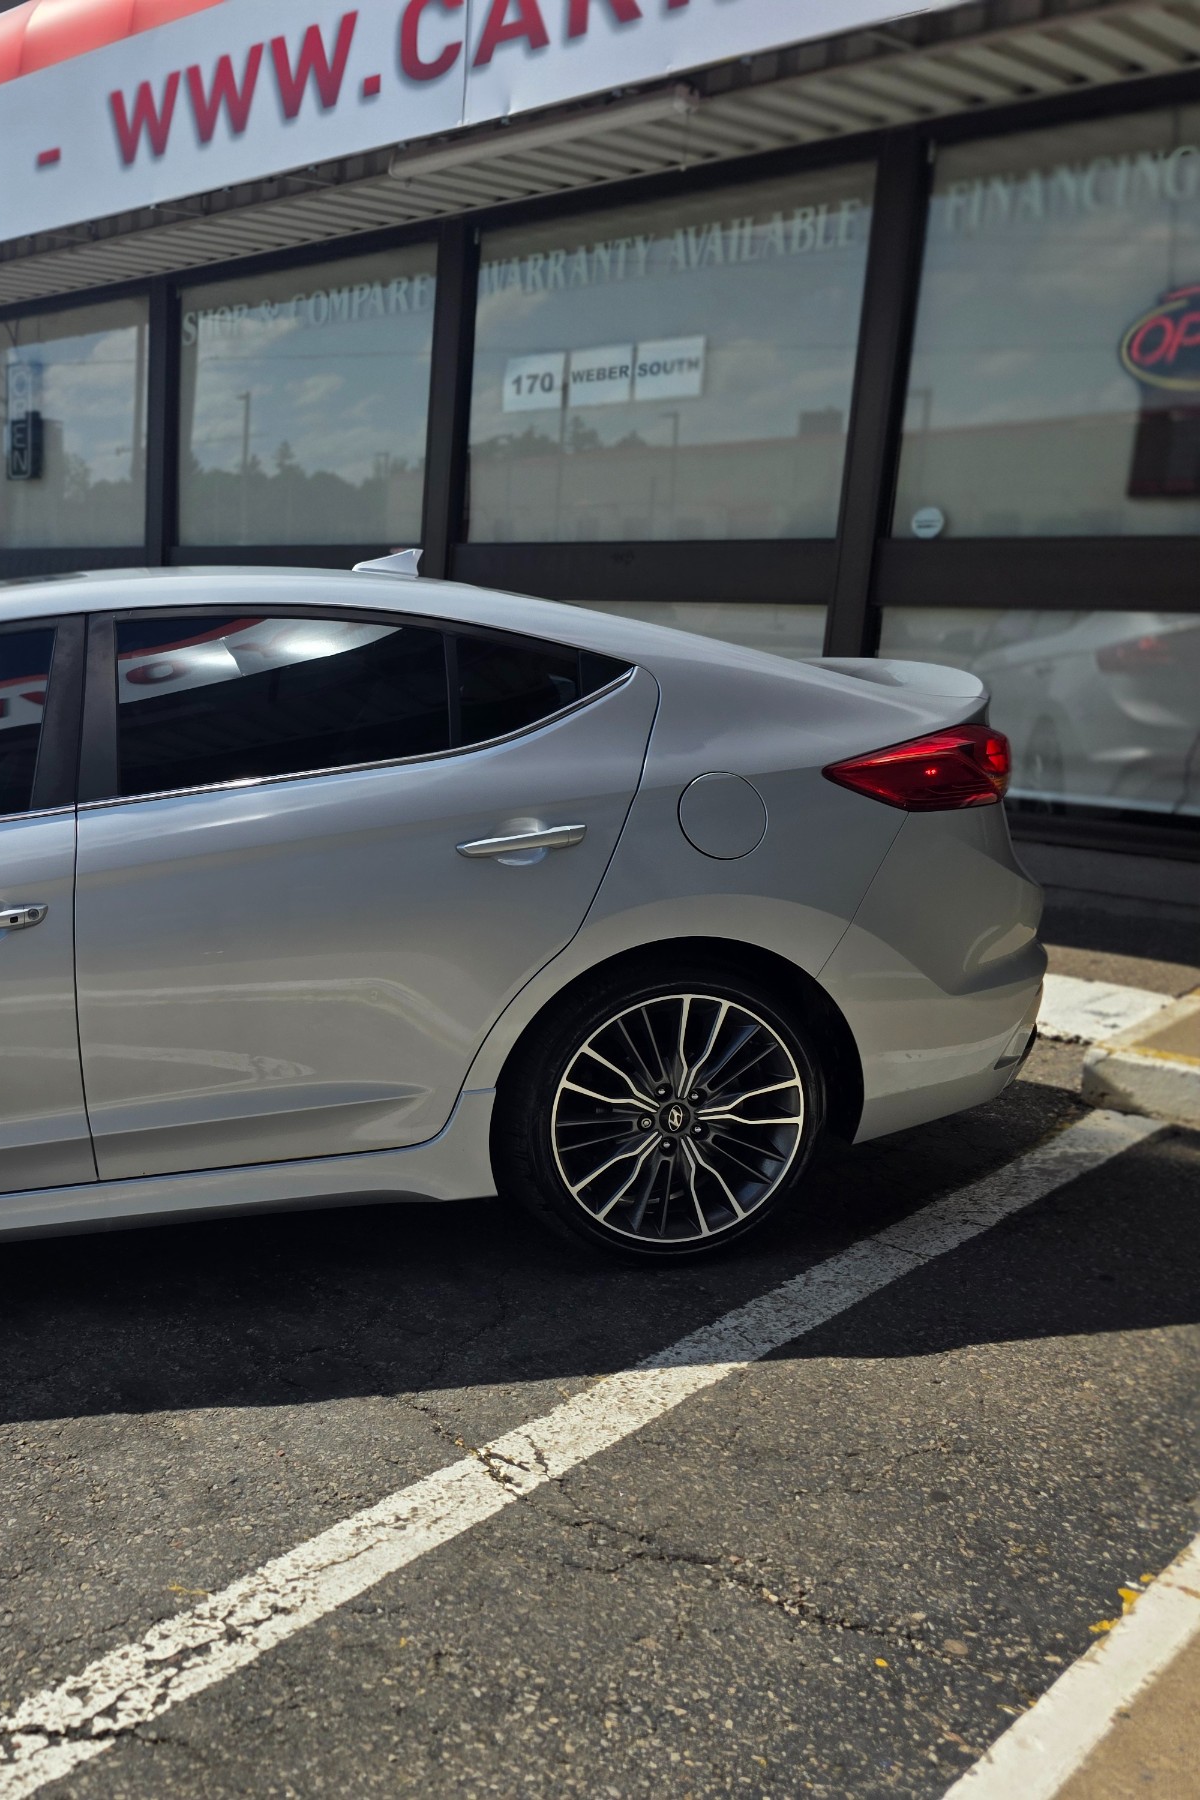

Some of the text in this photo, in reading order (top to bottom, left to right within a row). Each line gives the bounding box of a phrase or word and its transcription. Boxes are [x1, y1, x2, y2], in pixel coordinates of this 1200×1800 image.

[110, 0, 693, 165] WWW.CA
[948, 144, 1200, 238] FINANCING
[481, 197, 862, 297] WARRANTY AVAILABLE
[182, 302, 249, 346] SHOP
[291, 273, 435, 325] COMPARE
[510, 356, 701, 395] 170 WEBER SOUTH
